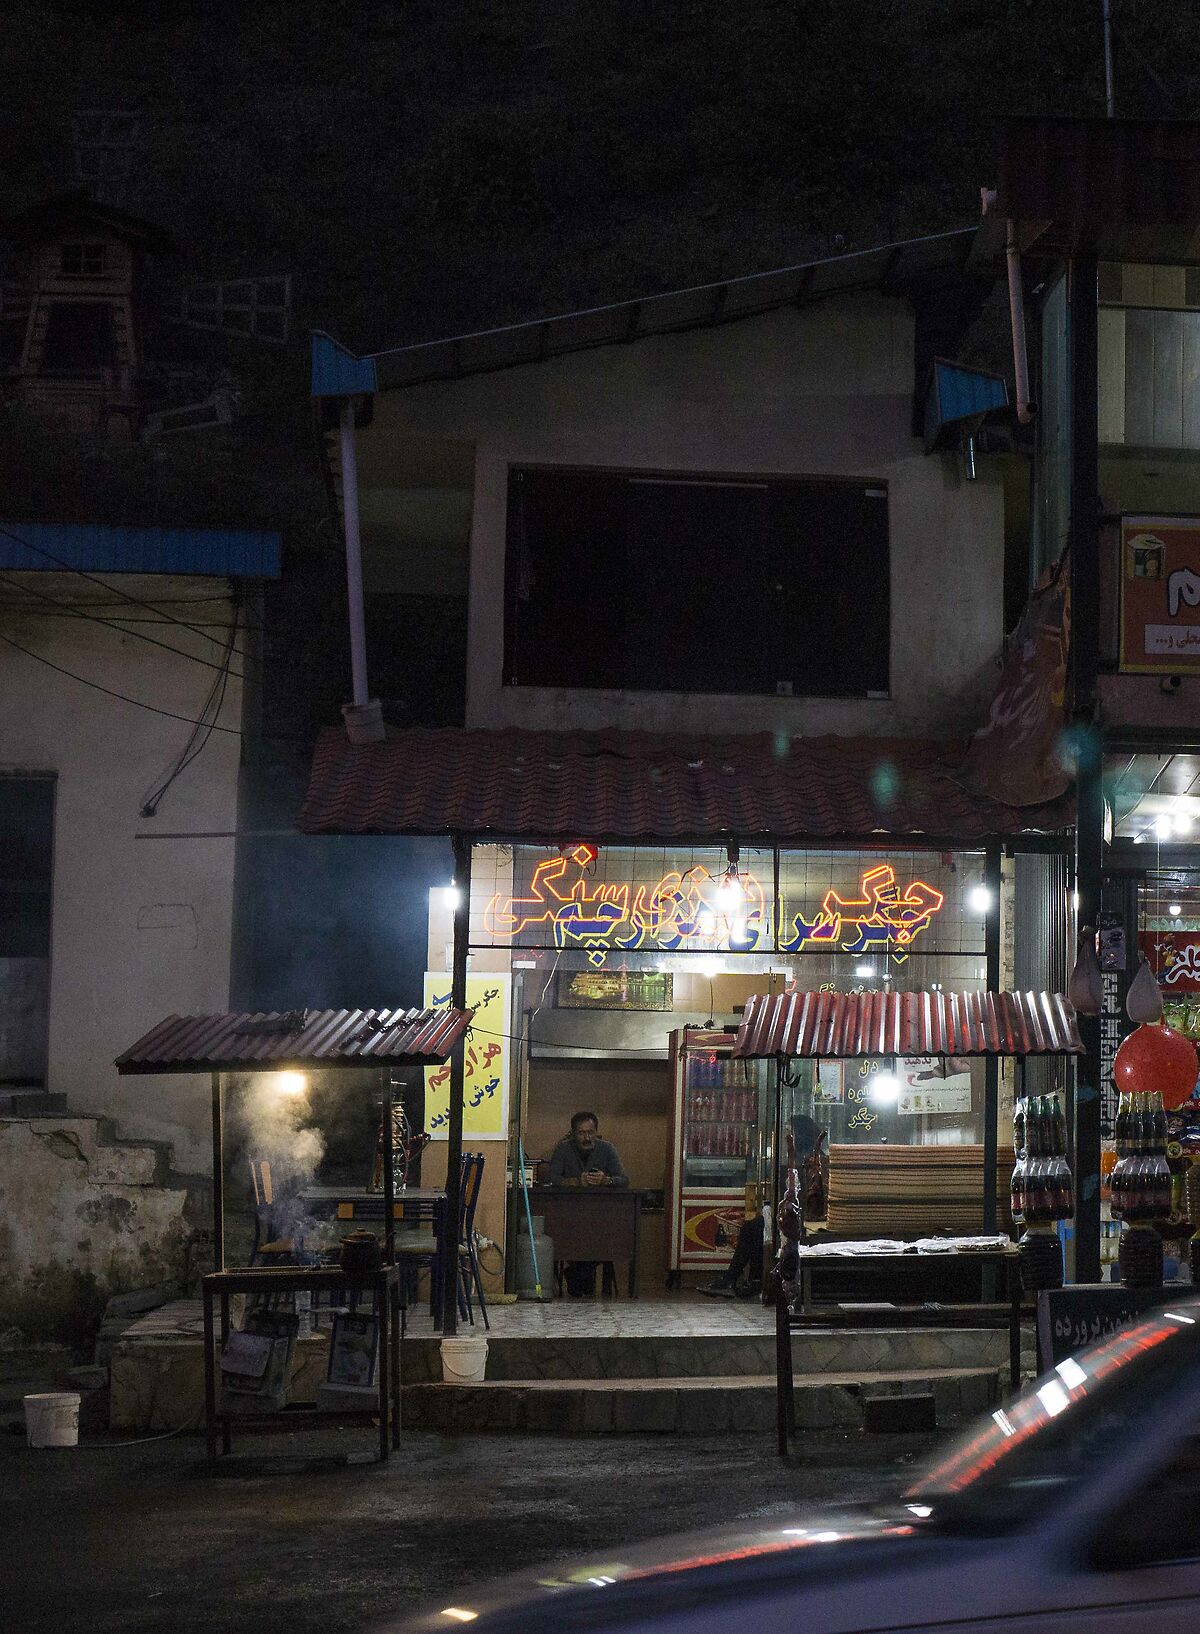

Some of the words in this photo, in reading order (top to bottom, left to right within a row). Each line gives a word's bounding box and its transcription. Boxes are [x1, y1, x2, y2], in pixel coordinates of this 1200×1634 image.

[484, 845, 630, 936] سنگی
[811, 864, 944, 945] جگر
[469, 1074, 500, 1108] خوش
